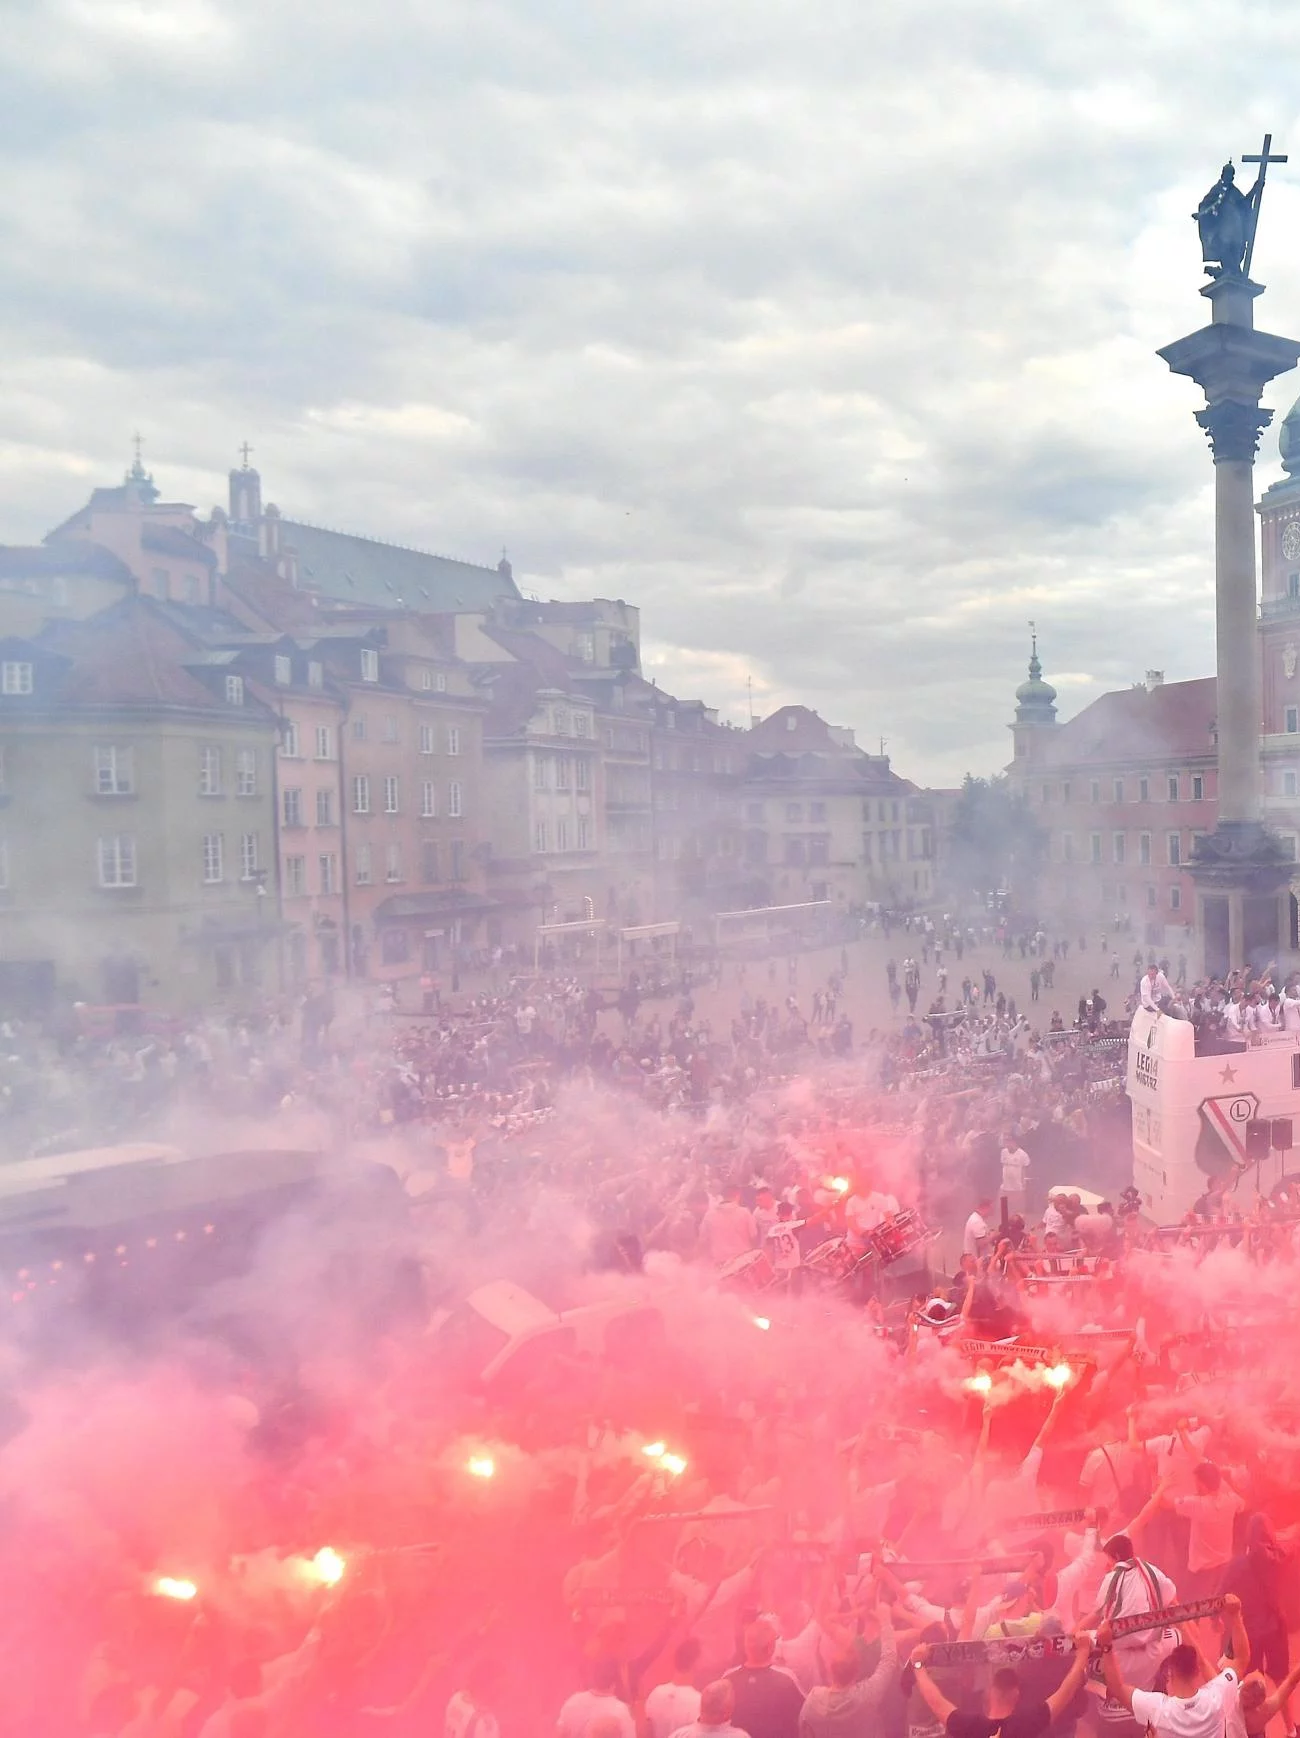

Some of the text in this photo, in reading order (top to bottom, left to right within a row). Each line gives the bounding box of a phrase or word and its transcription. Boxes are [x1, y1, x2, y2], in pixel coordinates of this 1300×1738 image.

[1137, 1052, 1159, 1077] LEG14
[1136, 1070, 1158, 1091] MISTRZ
[1236, 1103, 1246, 1118] L
